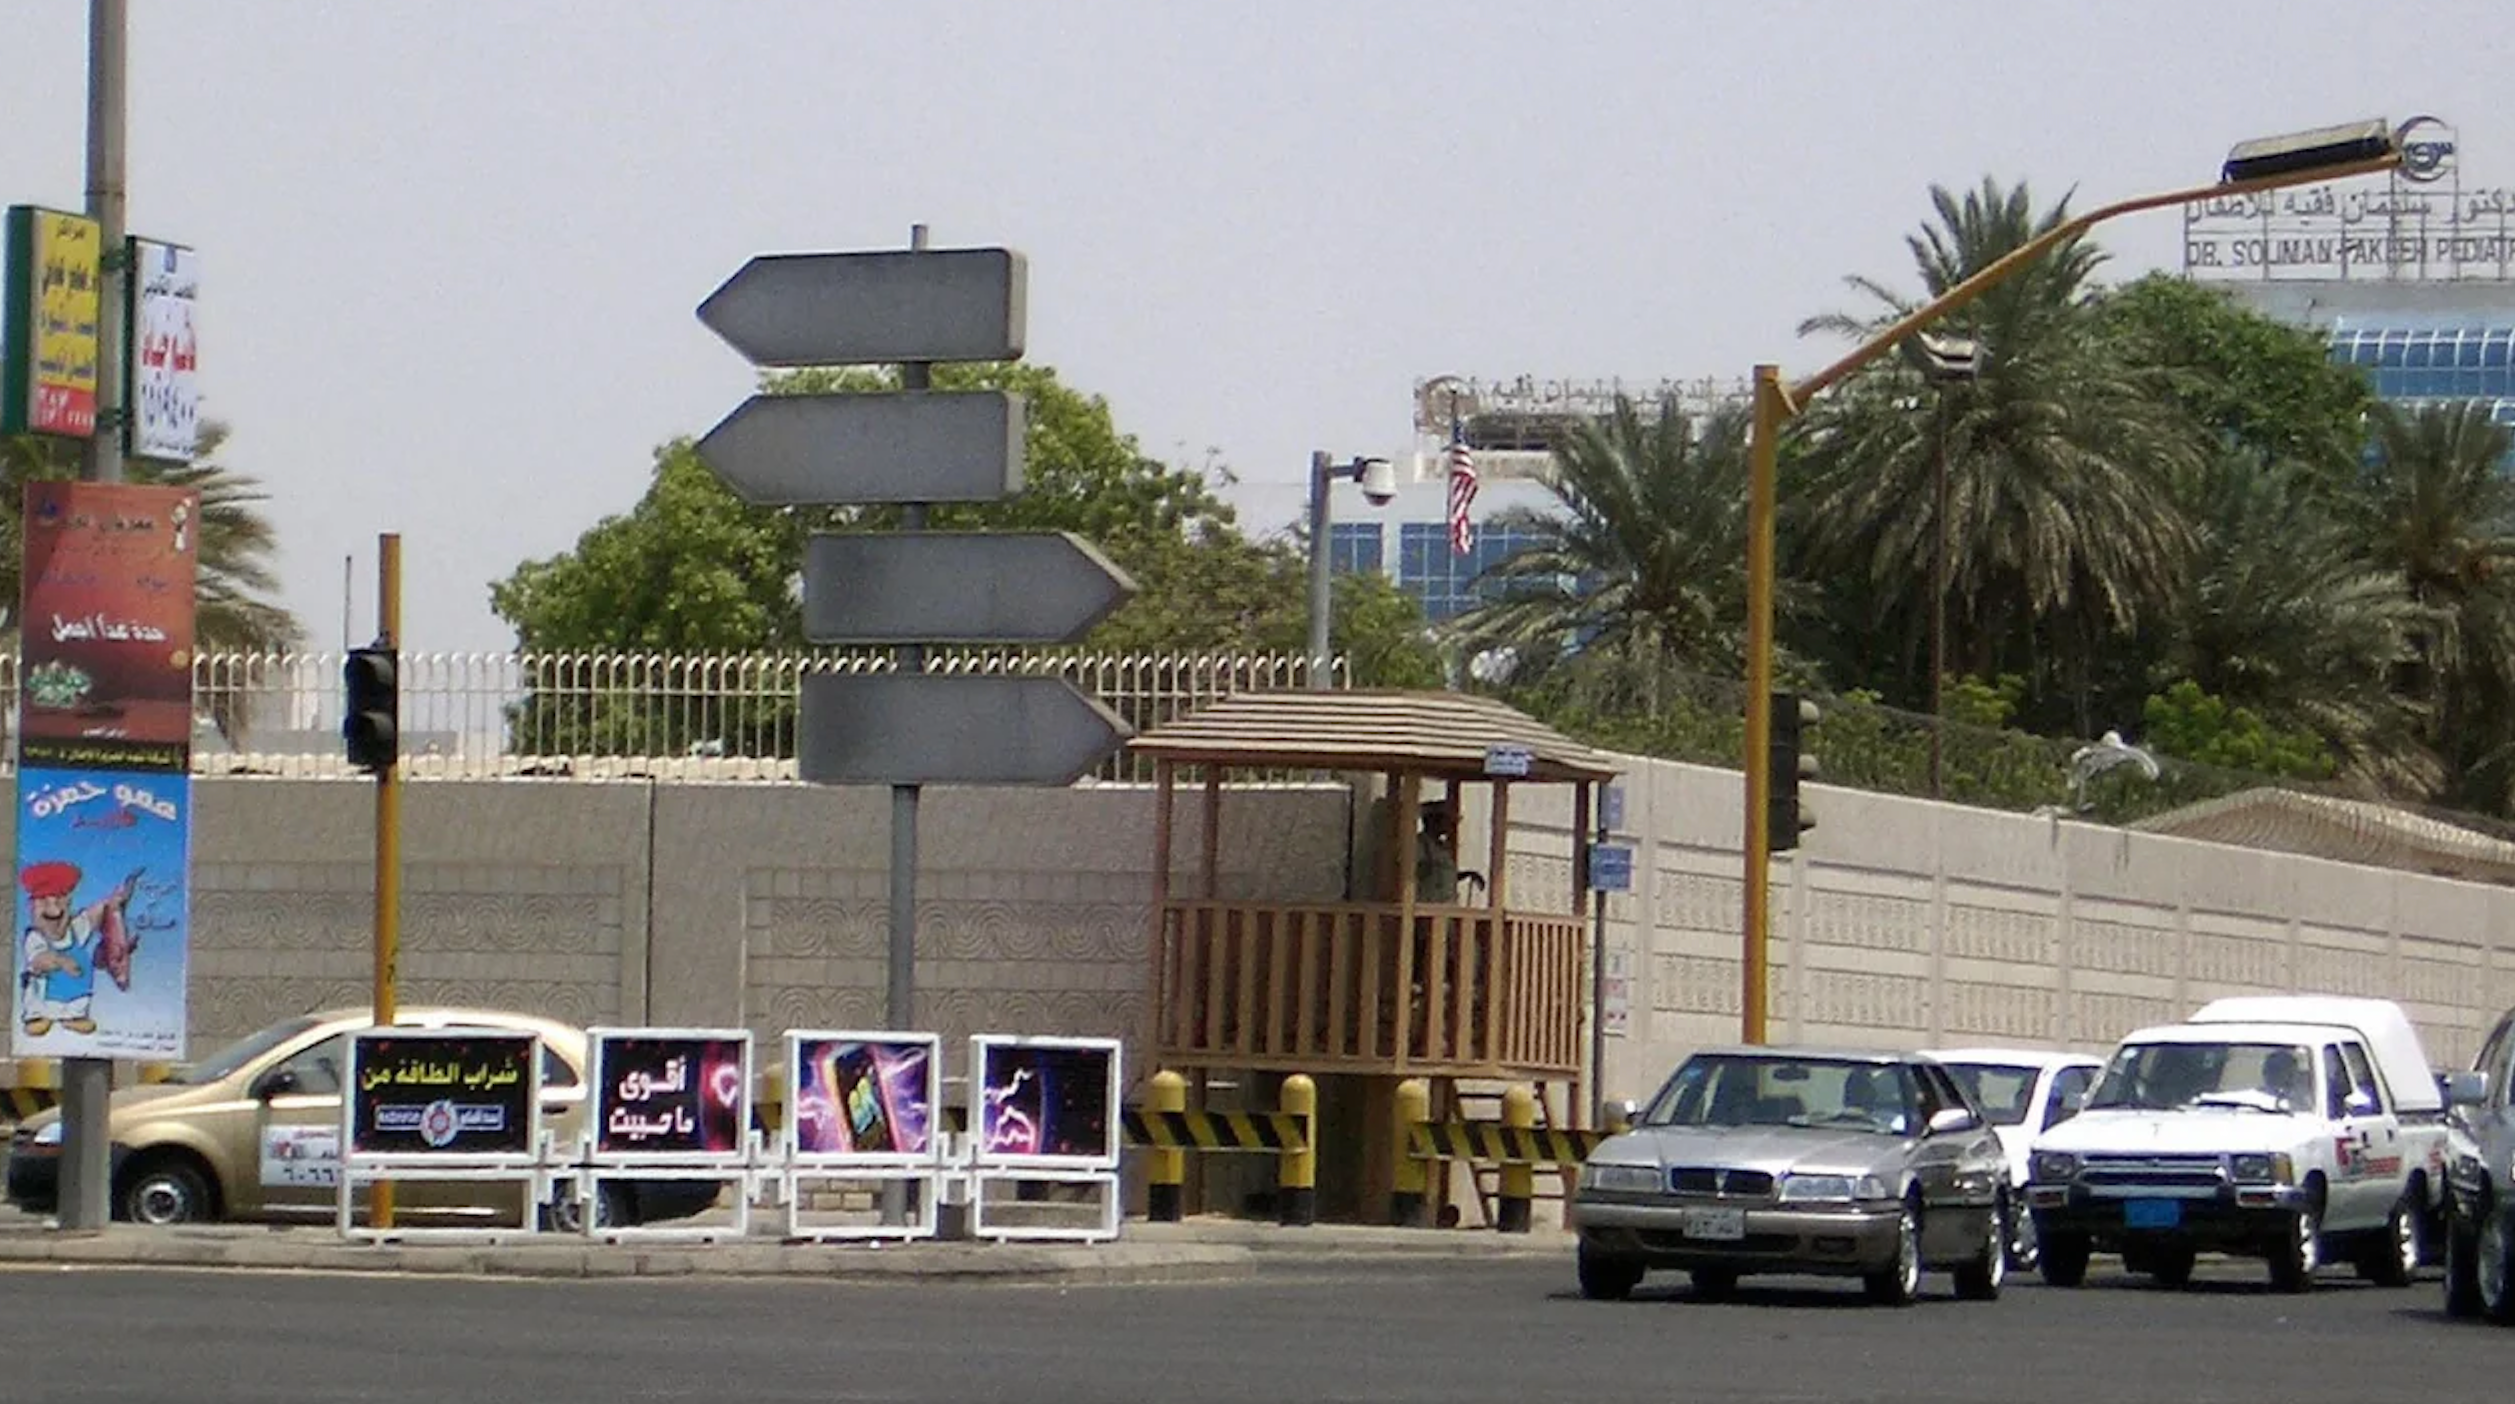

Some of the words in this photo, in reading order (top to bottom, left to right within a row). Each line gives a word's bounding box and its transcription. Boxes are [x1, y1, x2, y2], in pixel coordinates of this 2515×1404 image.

[2233, 239, 2331, 266] SOLIMAN
[362, 1067, 391, 1091] من
[395, 1058, 459, 1084] الطاقة
[464, 1057, 517, 1091] شراب
[619, 1055, 687, 1101] أقوى
